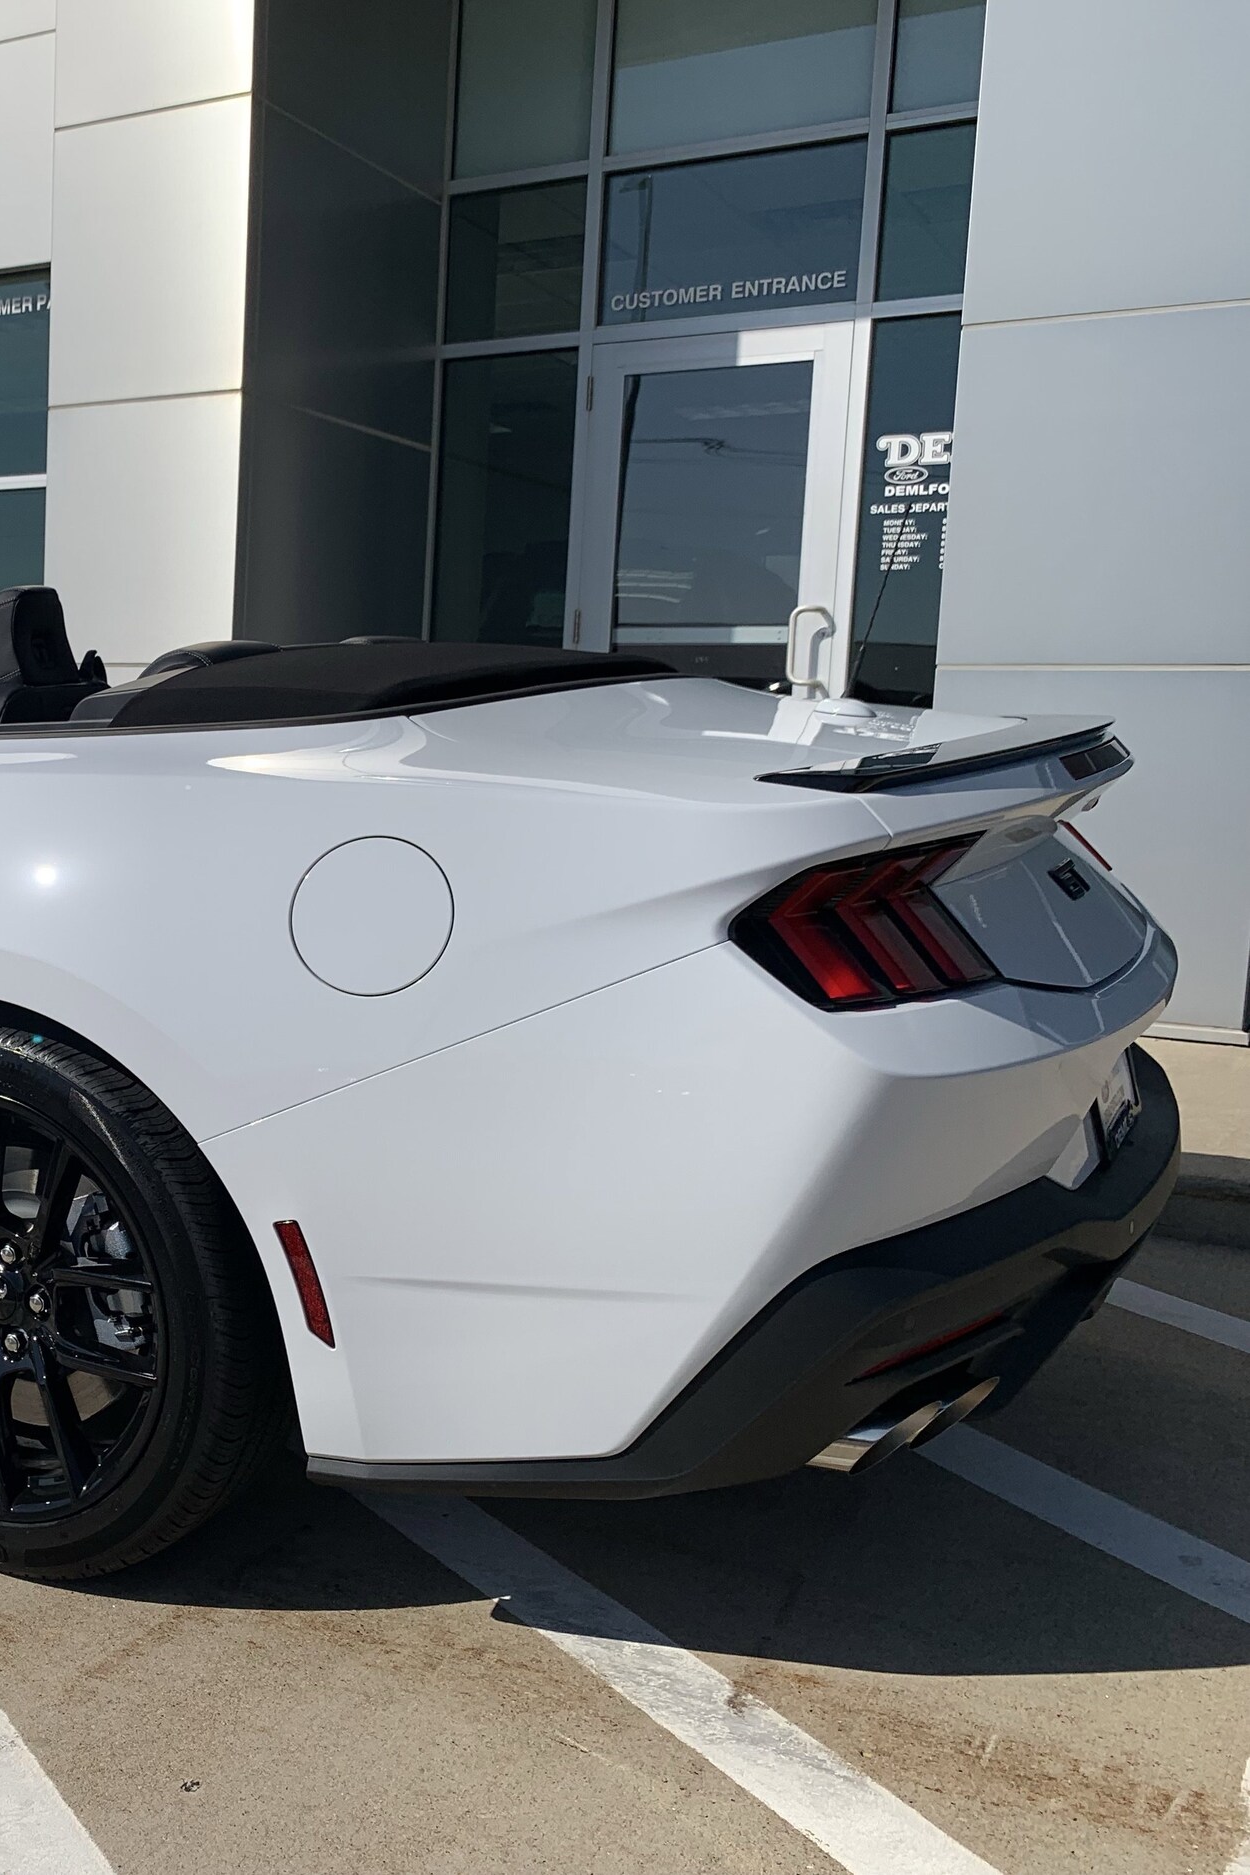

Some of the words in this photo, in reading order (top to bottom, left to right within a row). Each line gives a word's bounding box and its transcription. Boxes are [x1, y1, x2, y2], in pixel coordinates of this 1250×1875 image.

[611, 284, 722, 312] CUSTOMER
[731, 270, 847, 299] ENTRANCE
[876, 432, 954, 467] DE
[892, 469, 919, 481] Ford
[870, 504, 906, 515] SALES
